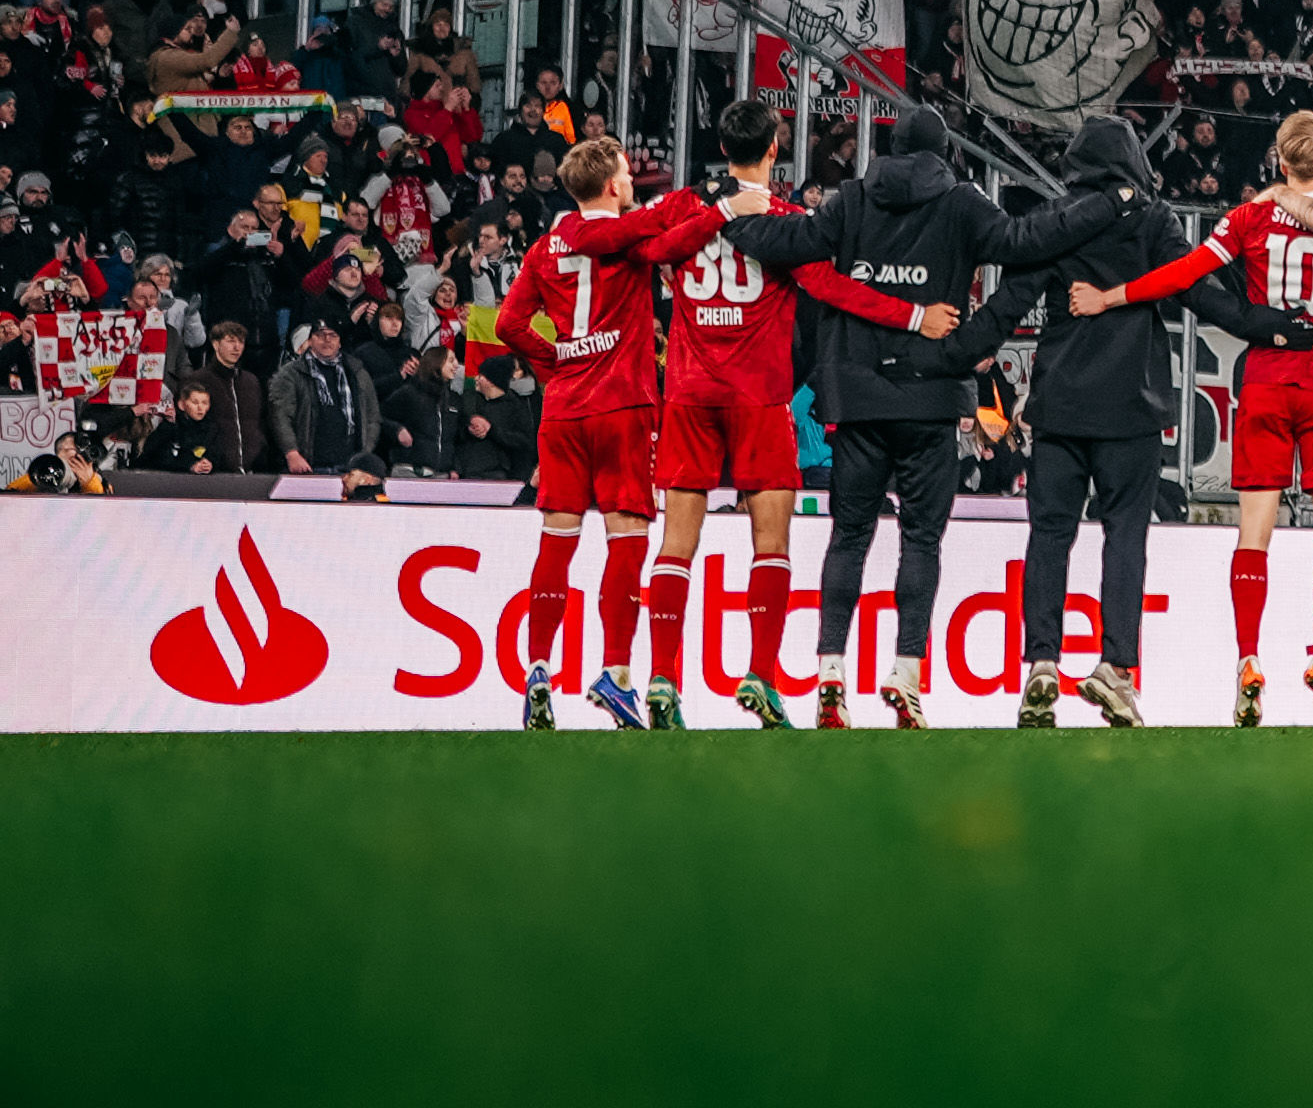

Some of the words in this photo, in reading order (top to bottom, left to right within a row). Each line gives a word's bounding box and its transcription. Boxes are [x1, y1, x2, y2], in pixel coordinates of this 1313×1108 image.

[558, 255, 592, 338] 7
[874, 264, 929, 285] JAKO
[696, 306, 743, 325] CHEMA
[394, 545, 1170, 698] Satander
